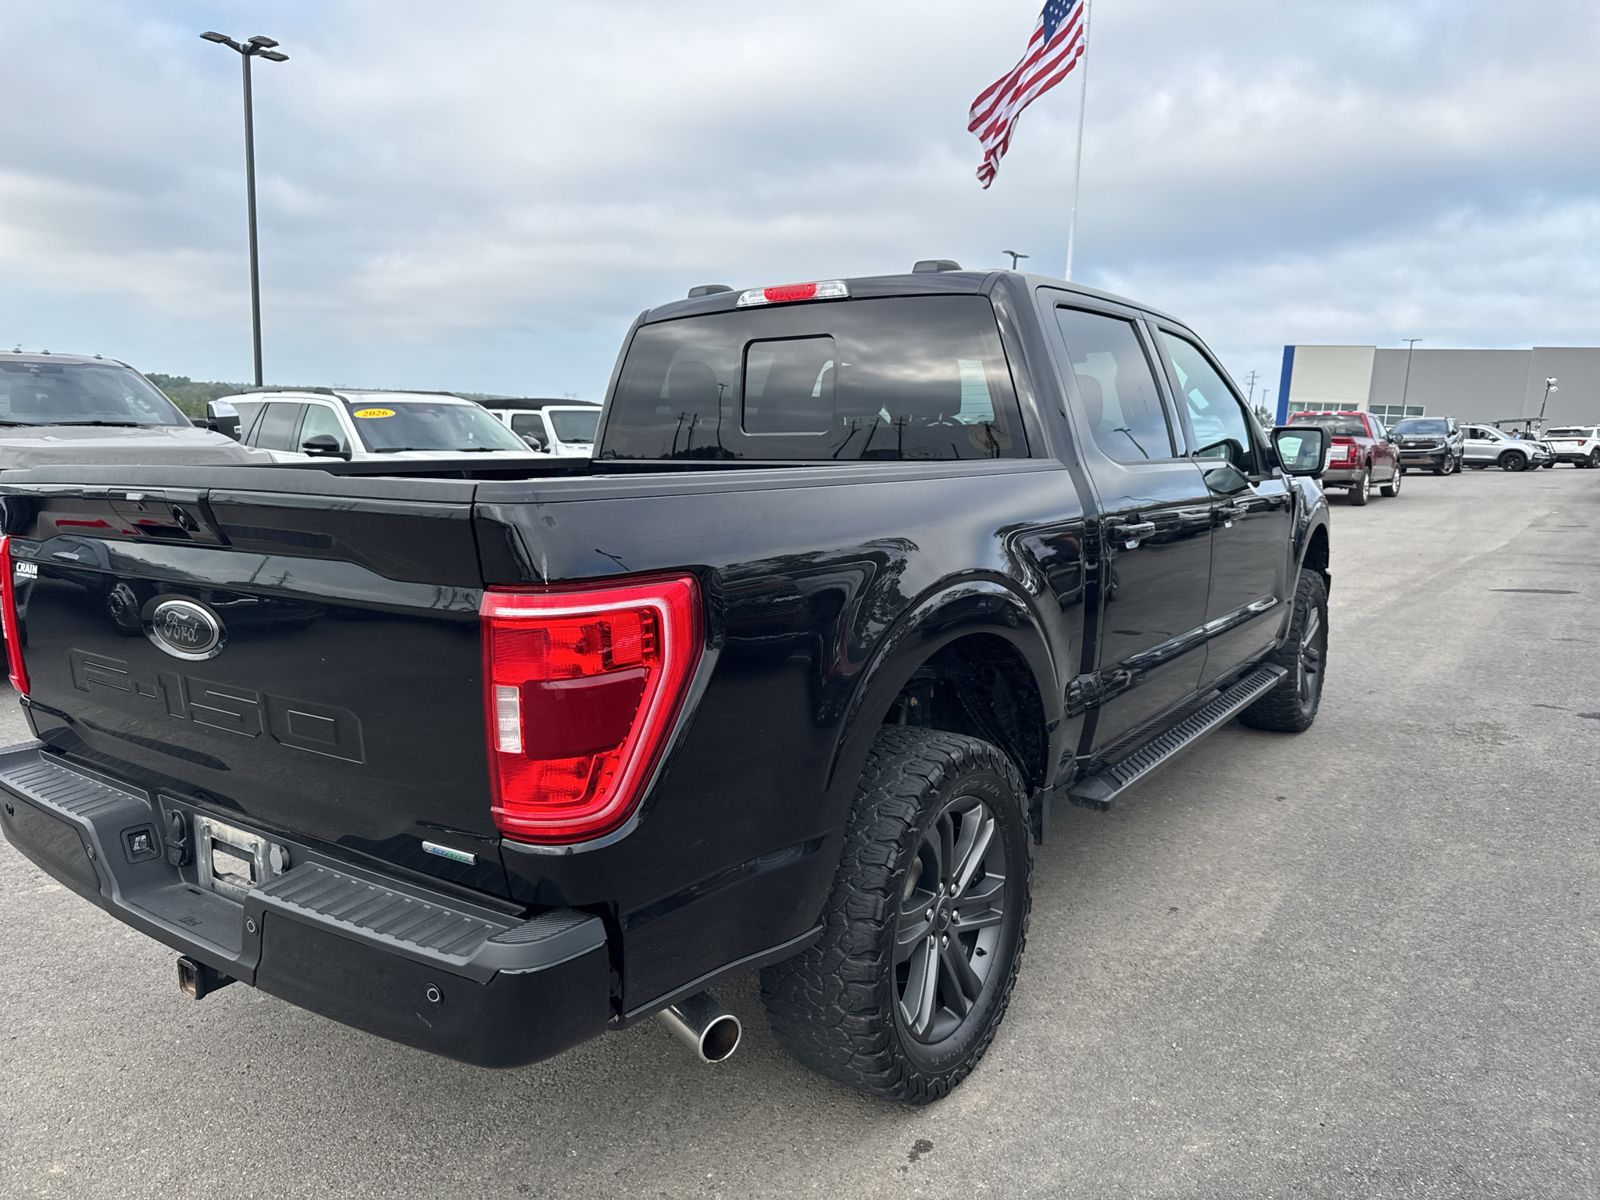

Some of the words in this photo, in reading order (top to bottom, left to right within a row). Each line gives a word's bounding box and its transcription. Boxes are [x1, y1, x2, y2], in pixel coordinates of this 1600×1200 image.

[16, 561, 38, 574] CRAIN
[164, 610, 199, 642] Ford
[69, 648, 366, 765] F-150
